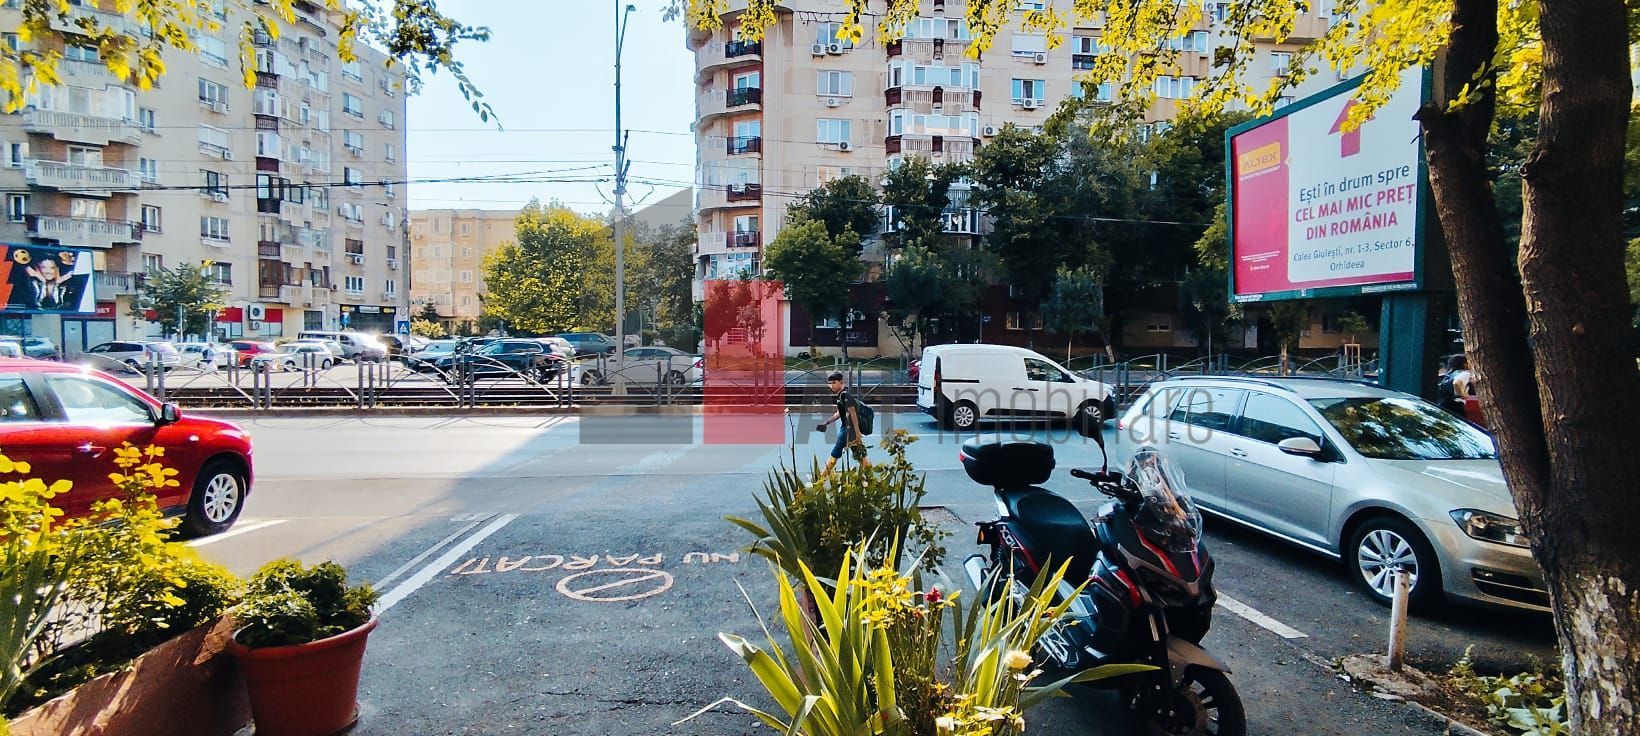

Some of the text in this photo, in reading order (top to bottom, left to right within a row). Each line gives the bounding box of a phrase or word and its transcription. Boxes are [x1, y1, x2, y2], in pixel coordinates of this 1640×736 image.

[1300, 165, 1409, 205] Ești în drum spre
[1295, 207, 1315, 222] CEL
[1318, 200, 1342, 218] MAI
[1347, 193, 1373, 212] MIC
[1306, 211, 1398, 240] DIN ROMÂNIA
[1375, 239, 1403, 251] Sector
[1330, 260, 1365, 271] Orhideea
[682, 552, 740, 564] NU
